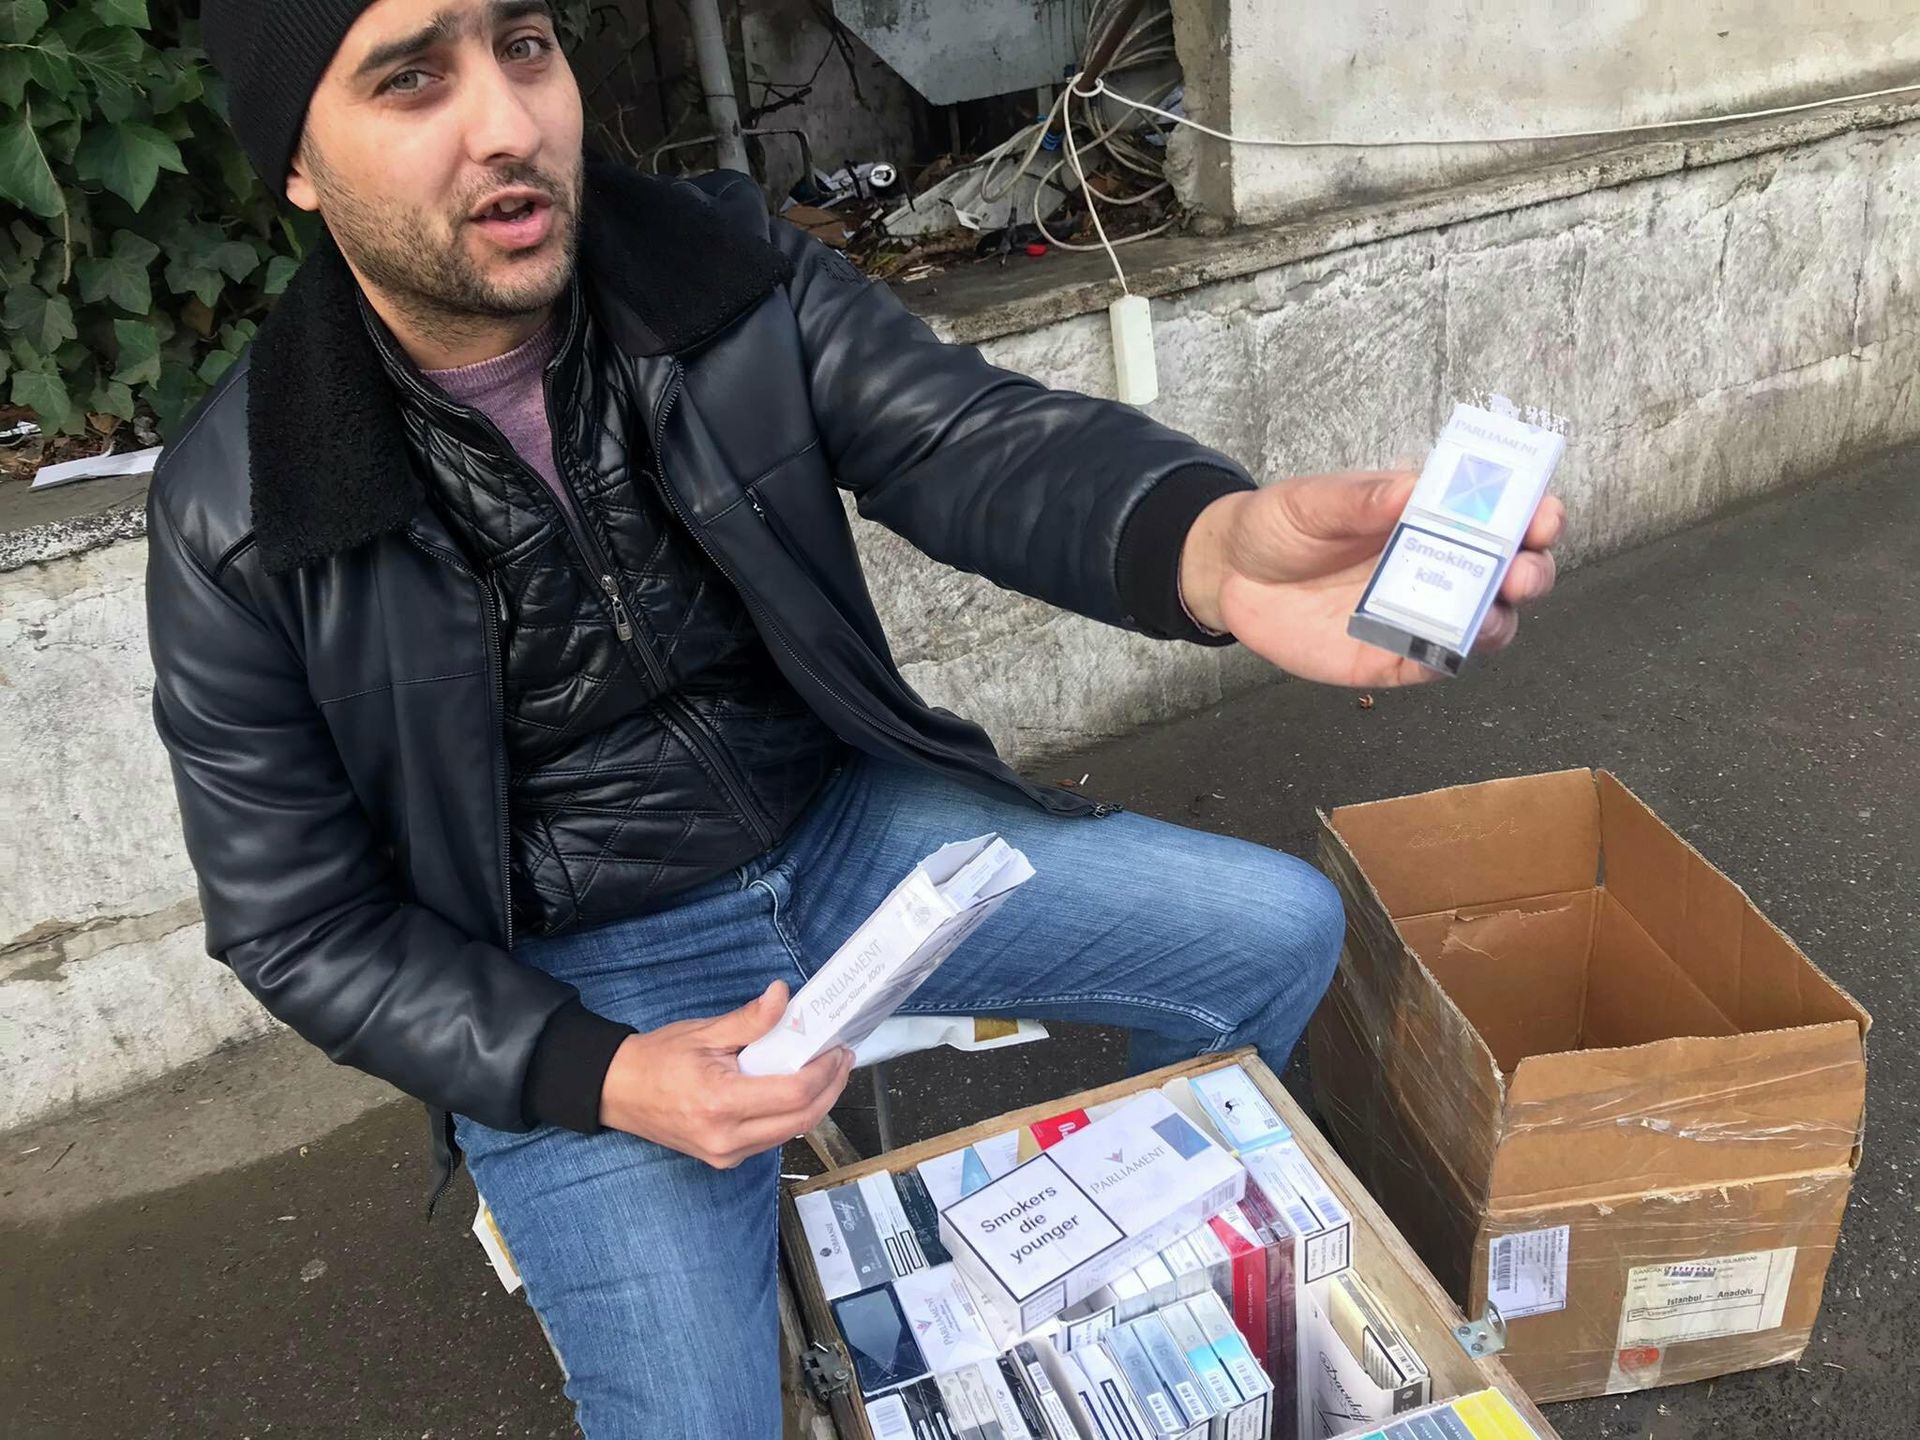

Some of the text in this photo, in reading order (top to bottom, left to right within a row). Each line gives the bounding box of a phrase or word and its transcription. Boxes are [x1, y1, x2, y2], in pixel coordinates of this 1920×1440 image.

[1454, 420, 1539, 456] PARLIAMENT
[1402, 536, 1487, 577] Smoking
[1414, 567, 1454, 592] kills
[810, 939, 882, 1016] PARLIAMENT
[1089, 1143, 1167, 1195] PARLIAMENT
[980, 1185, 1057, 1234] Smokers
[1019, 1213, 1047, 1235] die
[1010, 1213, 1080, 1264] younger
[1667, 1294, 1702, 1306] Istanbul
[1717, 1287, 1754, 1299] Anadolu
[924, 1297, 953, 1346] PARLIAMENT
[1320, 1351, 1375, 1422] Davidoff
